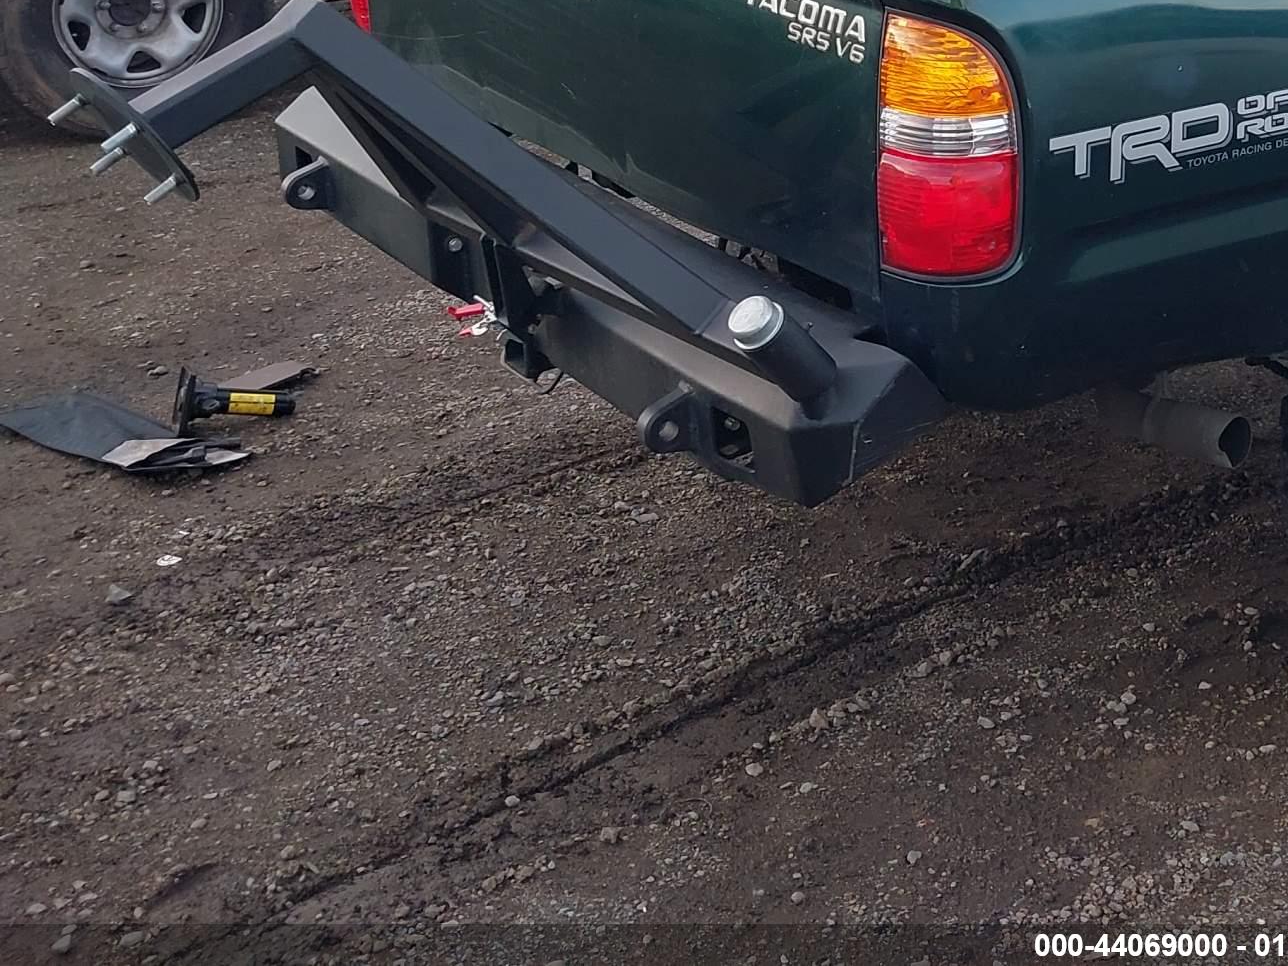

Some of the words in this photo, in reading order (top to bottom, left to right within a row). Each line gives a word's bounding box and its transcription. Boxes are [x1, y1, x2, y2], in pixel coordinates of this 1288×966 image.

[787, 21, 832, 52] SR5
[835, 37, 866, 64] V6
[1049, 102, 1234, 185] TRD
[1187, 151, 1229, 169] TOYOTA
[1231, 141, 1273, 160] RACING
